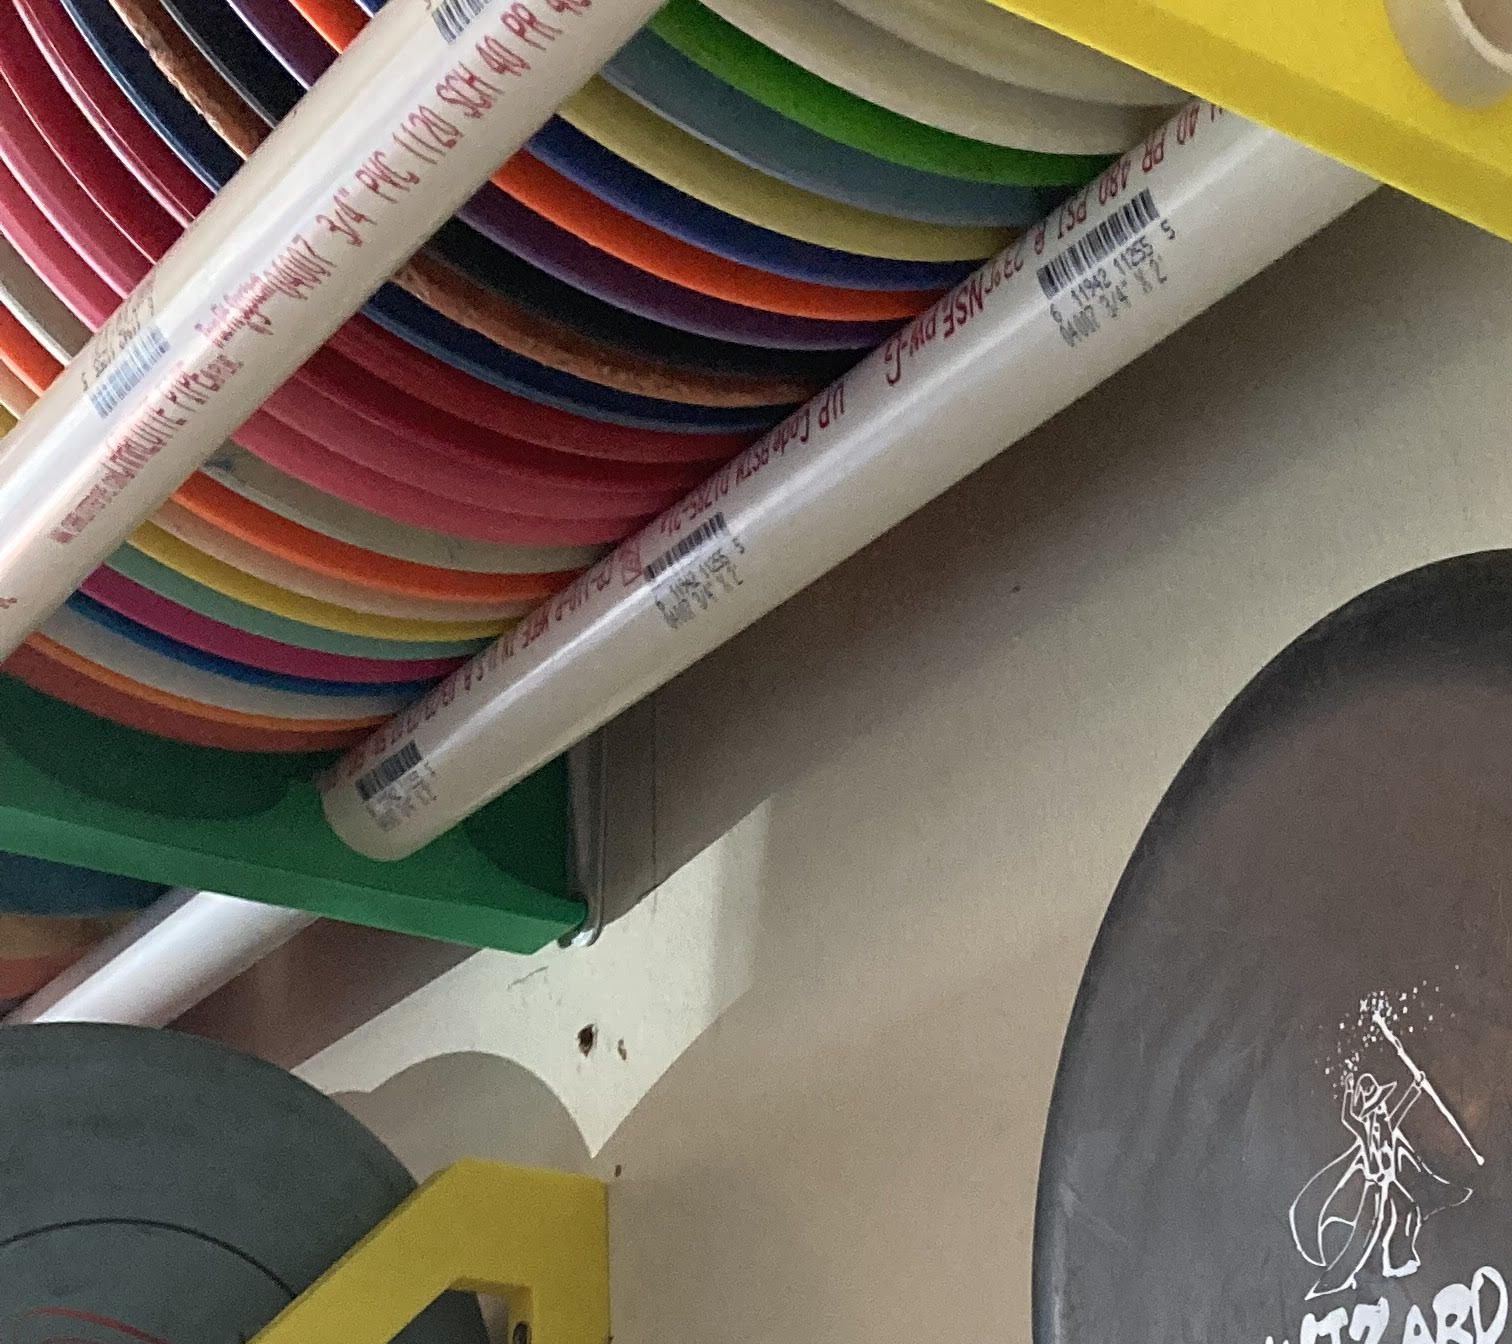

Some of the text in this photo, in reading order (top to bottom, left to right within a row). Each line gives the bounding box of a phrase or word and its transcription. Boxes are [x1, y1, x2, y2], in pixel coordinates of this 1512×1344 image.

[501, 2, 563, 50] PR
[475, 35, 531, 76] 40
[436, 61, 505, 118] SCH
[392, 105, 464, 165] 1120
[355, 150, 420, 203] PVC
[316, 187, 377, 247] 3/4"
